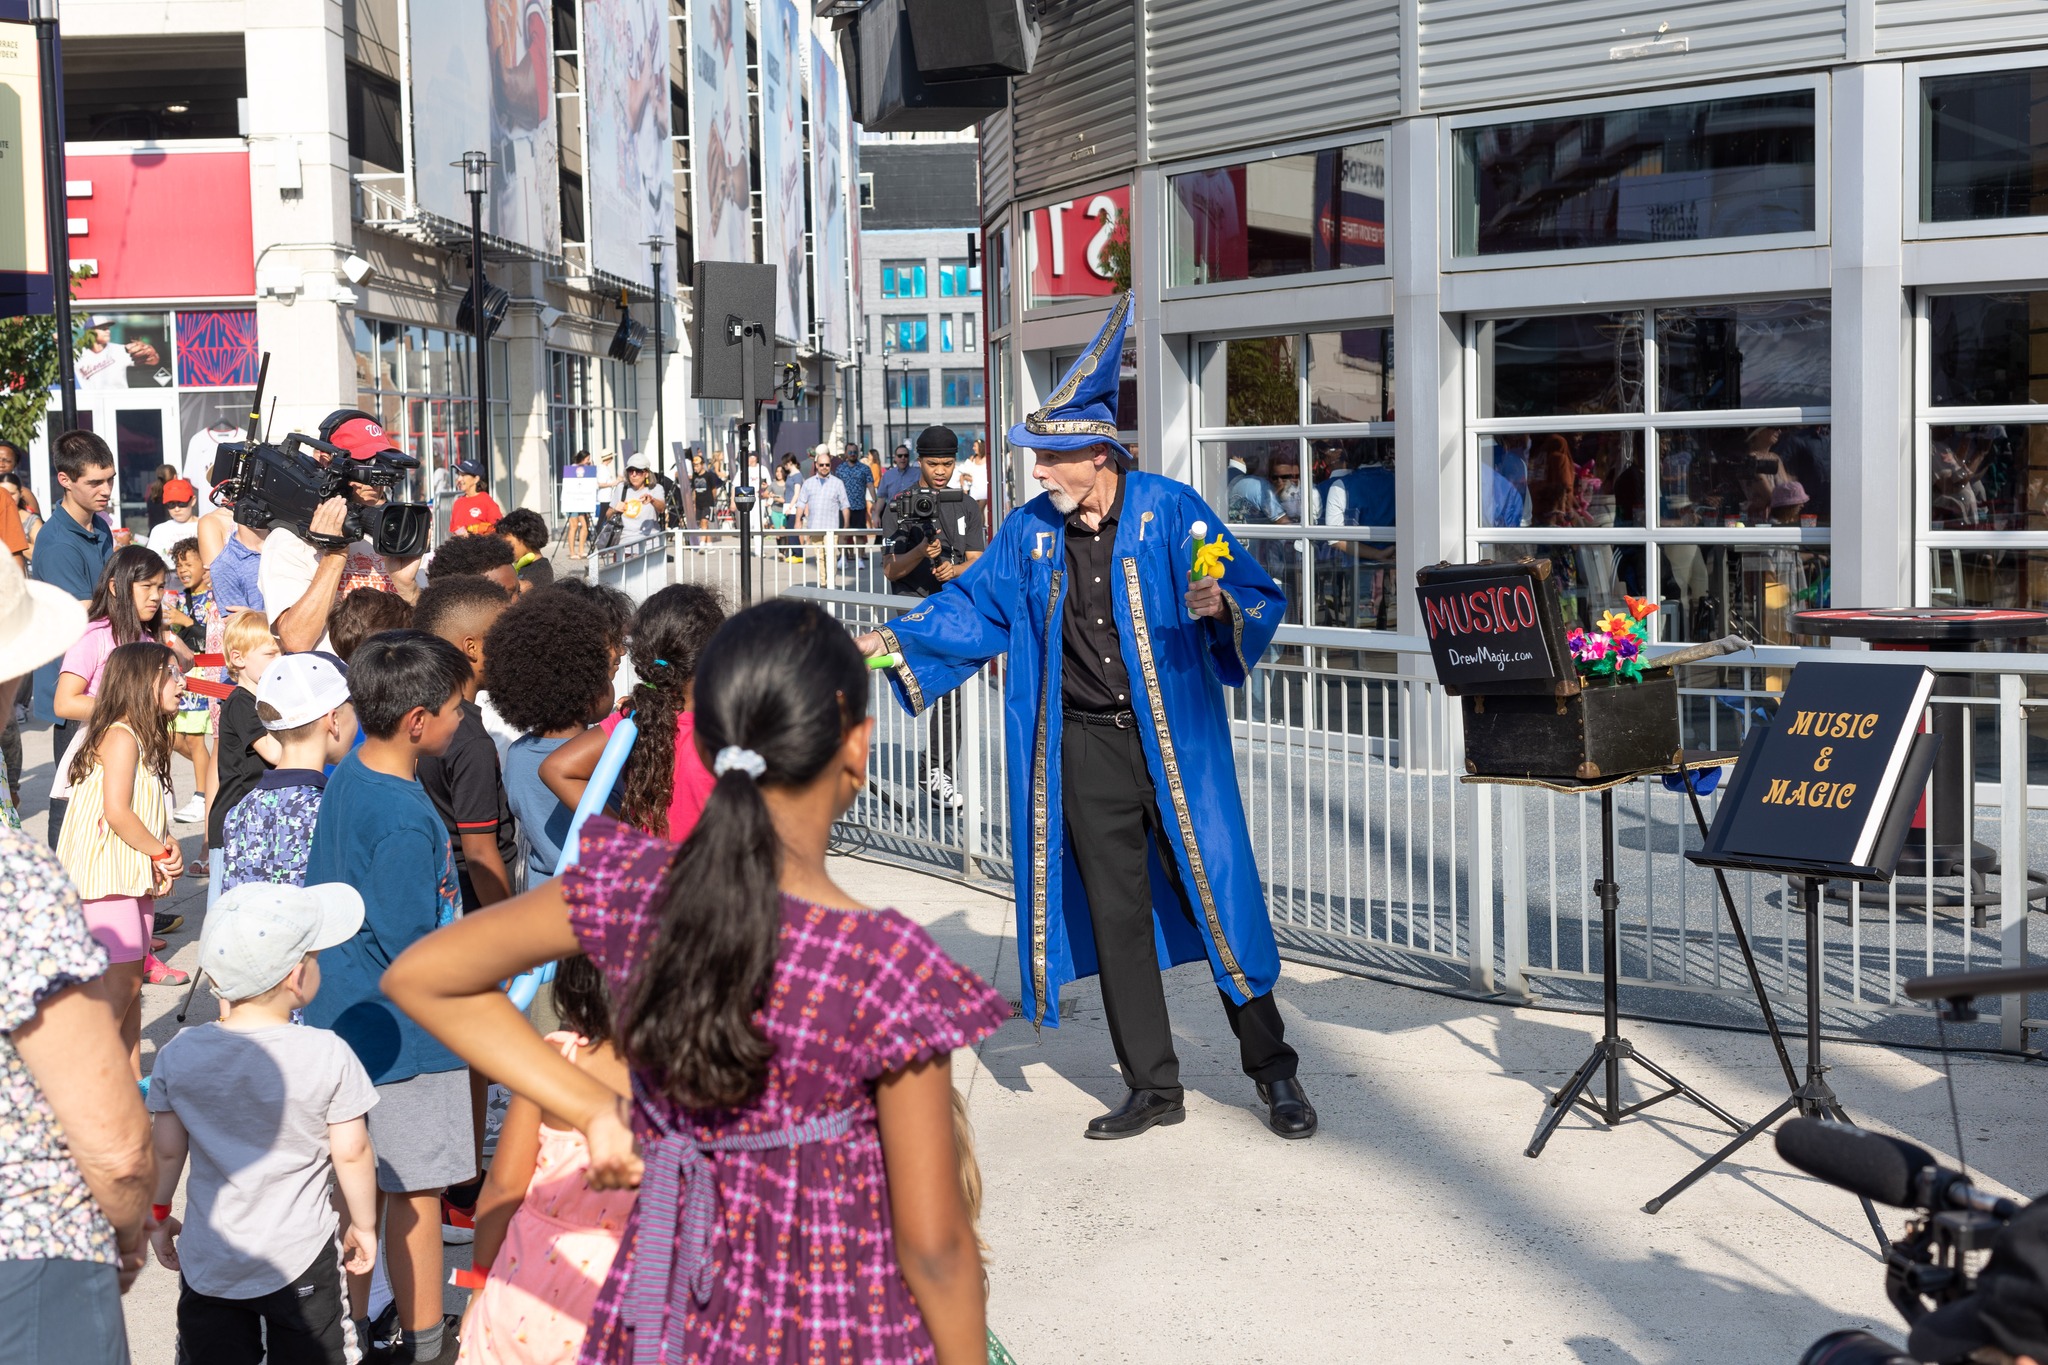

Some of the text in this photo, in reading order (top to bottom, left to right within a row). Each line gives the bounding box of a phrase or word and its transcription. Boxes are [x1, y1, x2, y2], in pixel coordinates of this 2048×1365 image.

[1425, 585, 1535, 640] MUSICO
[1448, 646, 1533, 671] DrewMagic.com
[1787, 711, 1879, 739] MUSIC
[1813, 746, 1833, 772] &
[1762, 779, 1857, 809] MAGIC
